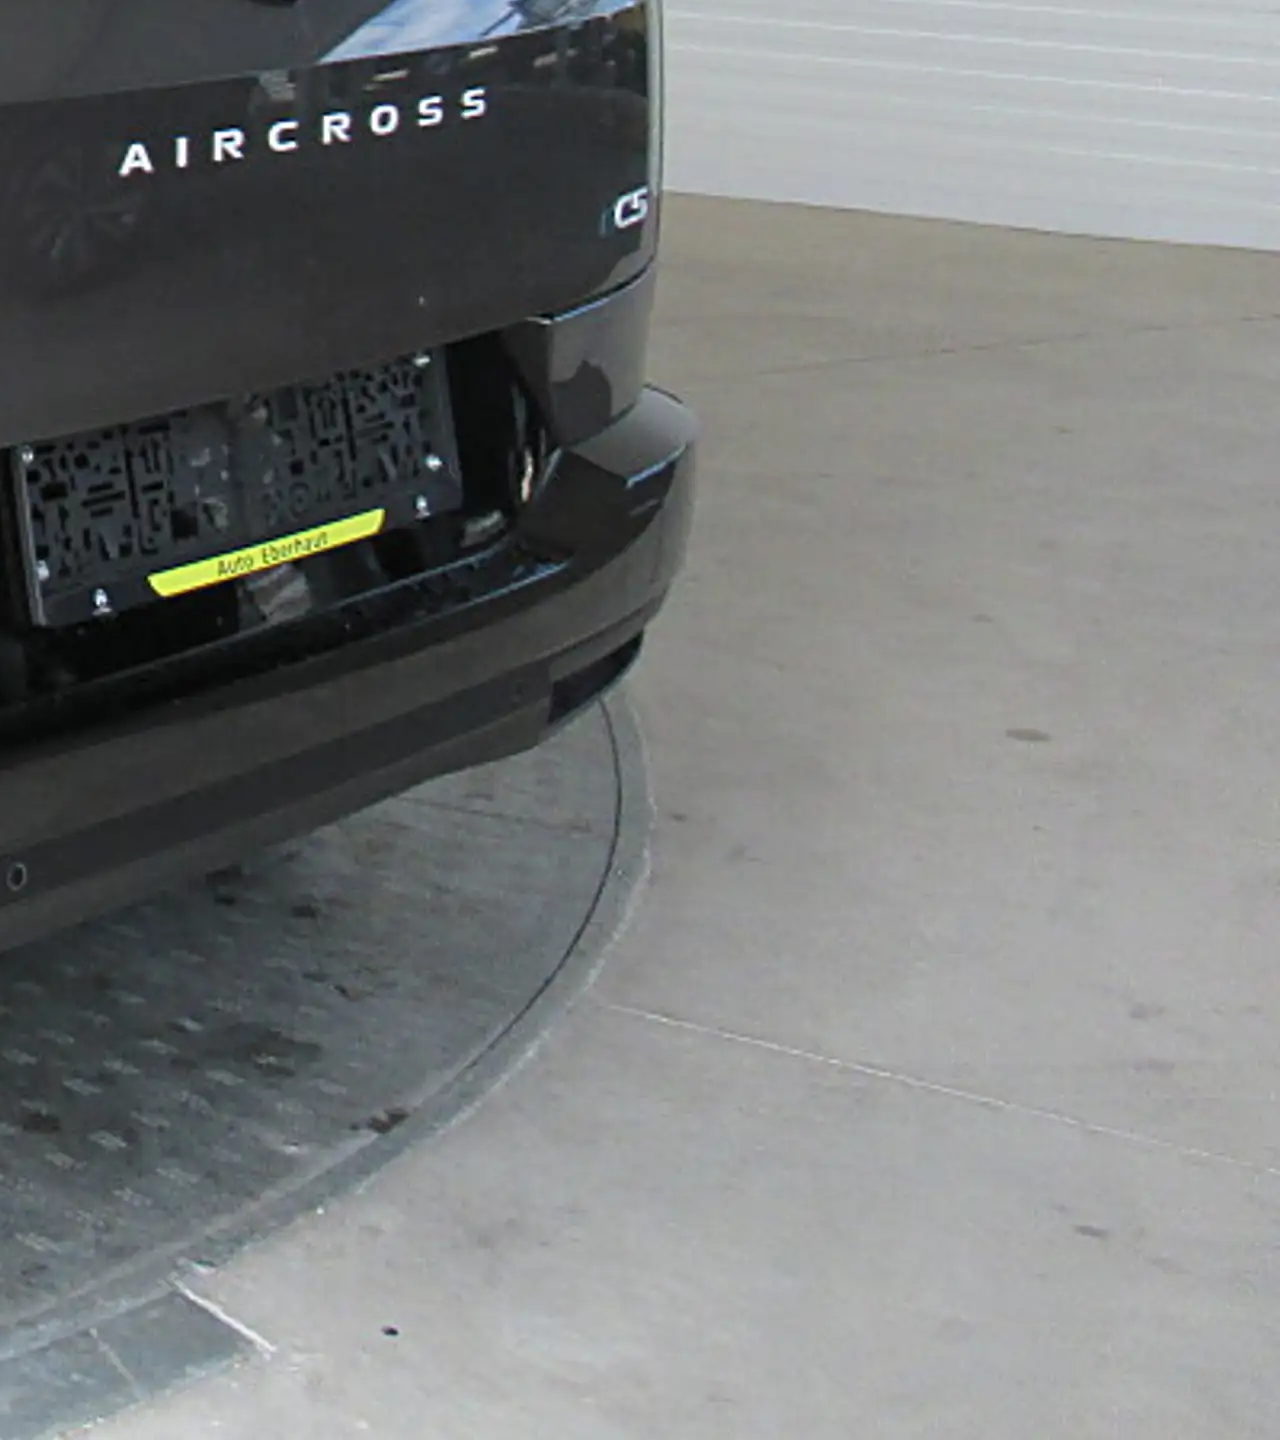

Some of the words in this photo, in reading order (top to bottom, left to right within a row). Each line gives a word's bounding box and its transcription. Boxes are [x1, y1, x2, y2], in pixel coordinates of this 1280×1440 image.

[119, 88, 487, 176] AIRCROSS
[613, 186, 649, 229] C5
[216, 553, 255, 577] Auto
[262, 531, 330, 564] Eberhaut
